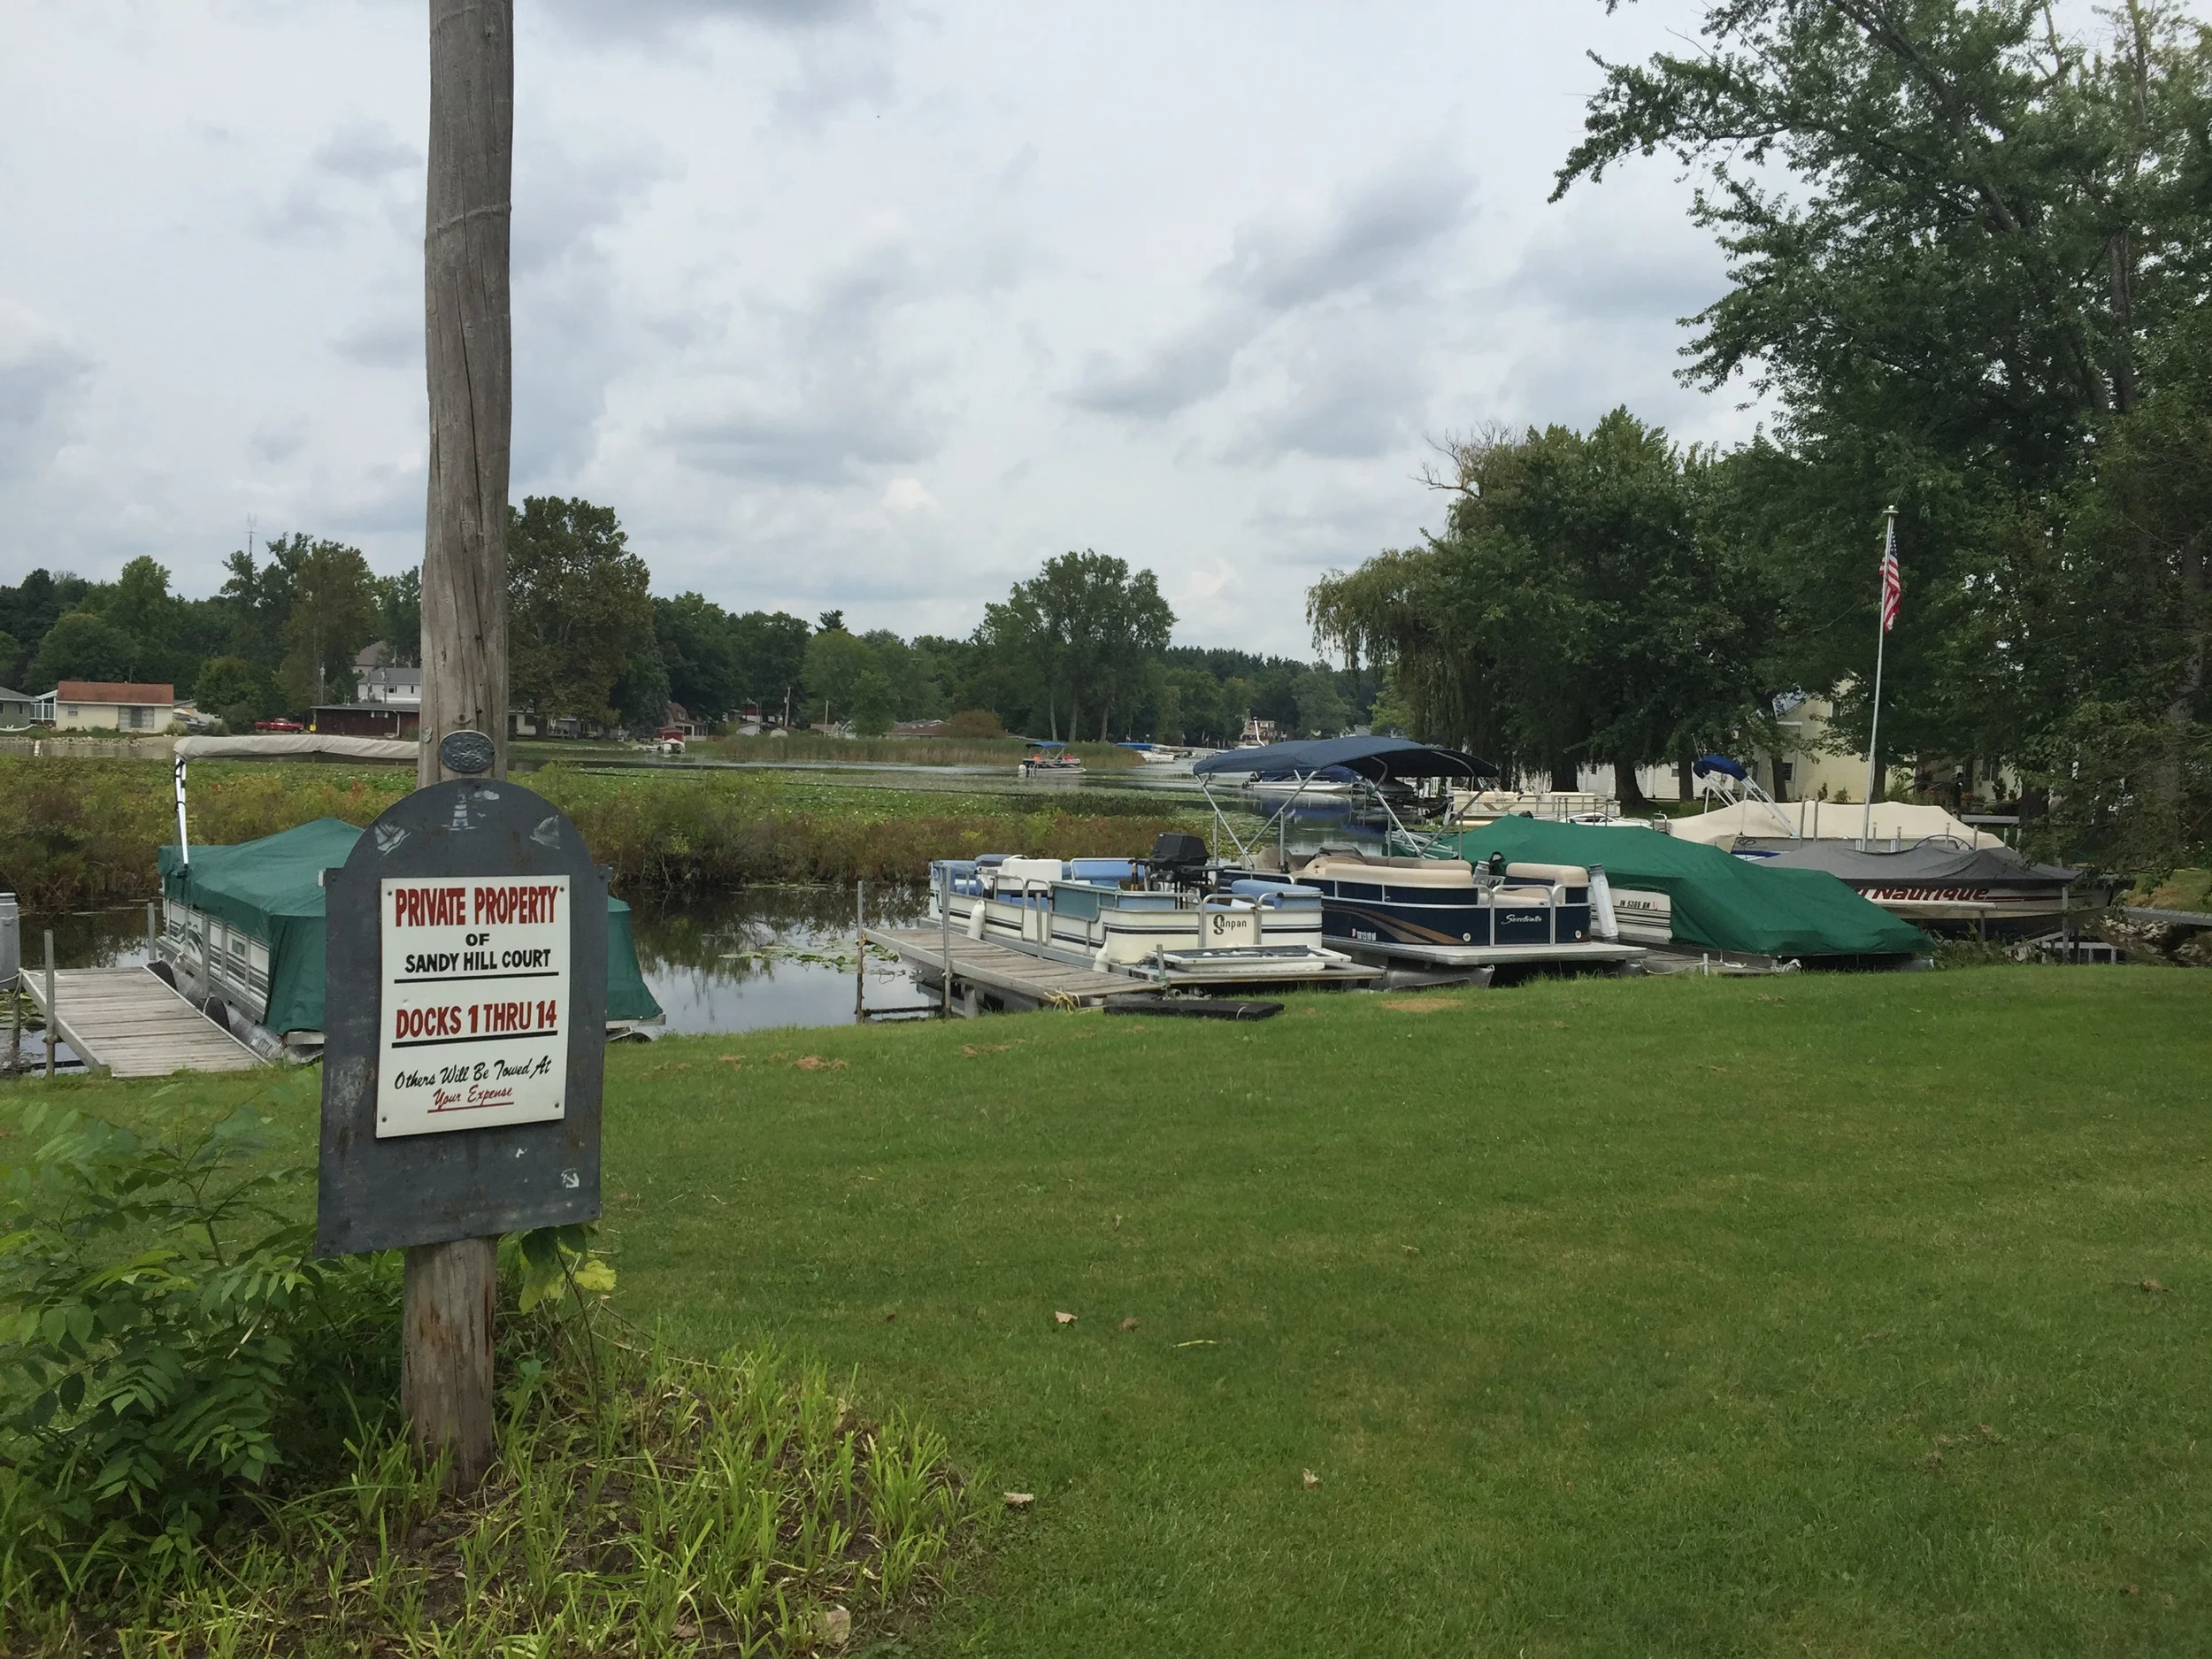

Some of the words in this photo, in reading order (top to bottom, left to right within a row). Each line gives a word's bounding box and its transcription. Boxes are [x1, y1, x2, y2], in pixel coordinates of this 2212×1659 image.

[1872, 887, 1990, 901] Nautique
[396, 887, 465, 927] PRIVATE
[474, 886, 558, 925] PROPERTY
[1213, 914, 1247, 935] Sanpan
[465, 933, 490, 946] OF
[405, 953, 460, 972] SANDY
[464, 951, 497, 971] HILL
[502, 949, 551, 968] COURT
[396, 1006, 462, 1039] DOCKS
[468, 1004, 479, 1033] 1
[483, 1002, 532, 1032] THRU
[536, 1000, 557, 1028] 14
[395, 1070, 435, 1089] Others
[440, 1064, 470, 1085] Will
[473, 1062, 489, 1081] Be
[494, 1058, 533, 1080] Towed
[529, 1056, 552, 1079] At
[433, 1088, 461, 1110] Your
[467, 1084, 512, 1105] Expense
